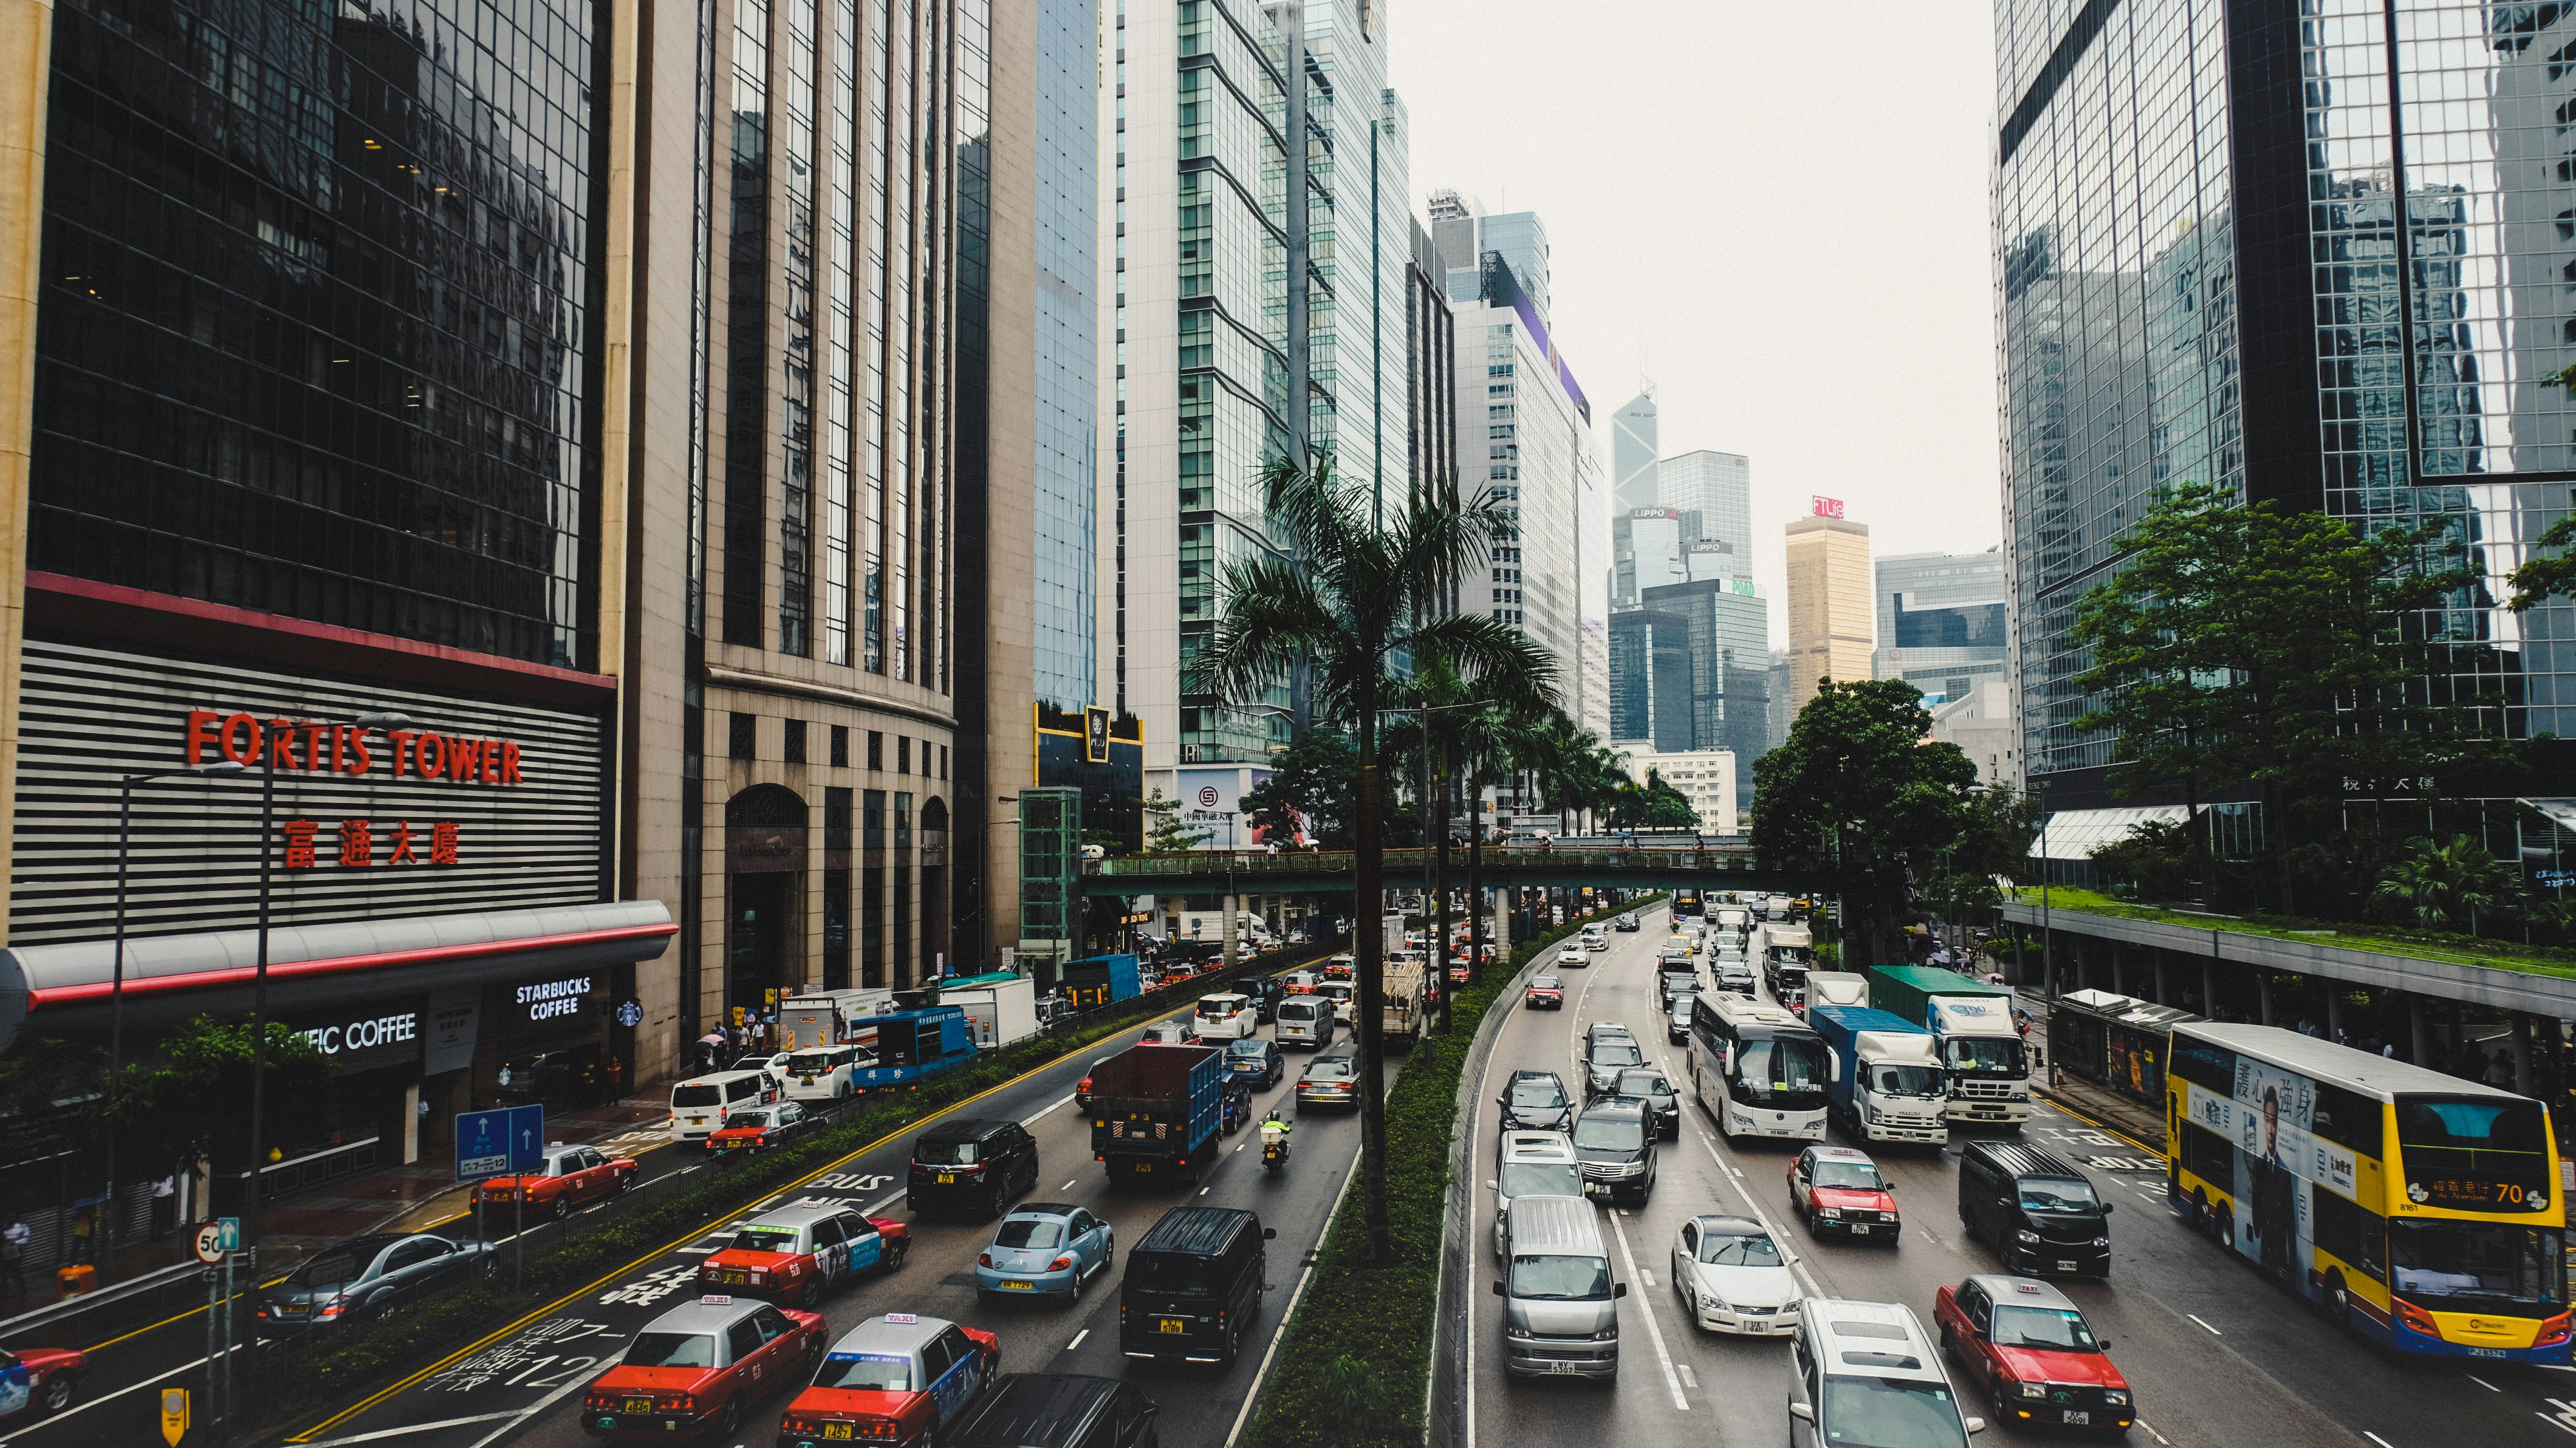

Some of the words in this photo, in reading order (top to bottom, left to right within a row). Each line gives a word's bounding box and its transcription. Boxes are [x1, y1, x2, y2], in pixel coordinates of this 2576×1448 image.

[1813, 496, 1844, 518] FTLife
[1691, 544, 1720, 552] LIPPO
[188, 709, 371, 775] FORTIS
[388, 731, 524, 784] TOWER
[284, 819, 460, 868] 富通大廈
[516, 977, 591, 1004] STARBUCKS
[530, 997, 578, 1021] COFFEE
[346, 1013, 416, 1050] COFFEE
[2236, 1062, 2312, 1123] 護心強身
[804, 1173, 894, 1190] BUS
[2496, 1183, 2523, 1204] 70
[524, 1319, 584, 1336] am
[888, 1314, 914, 1323] TAXI
[451, 1357, 530, 1370] NIGHT
[504, 1354, 598, 1387] 12
[2067, 1416, 2086, 1424] 5691
[827, 1429, 848, 1439] 1457
